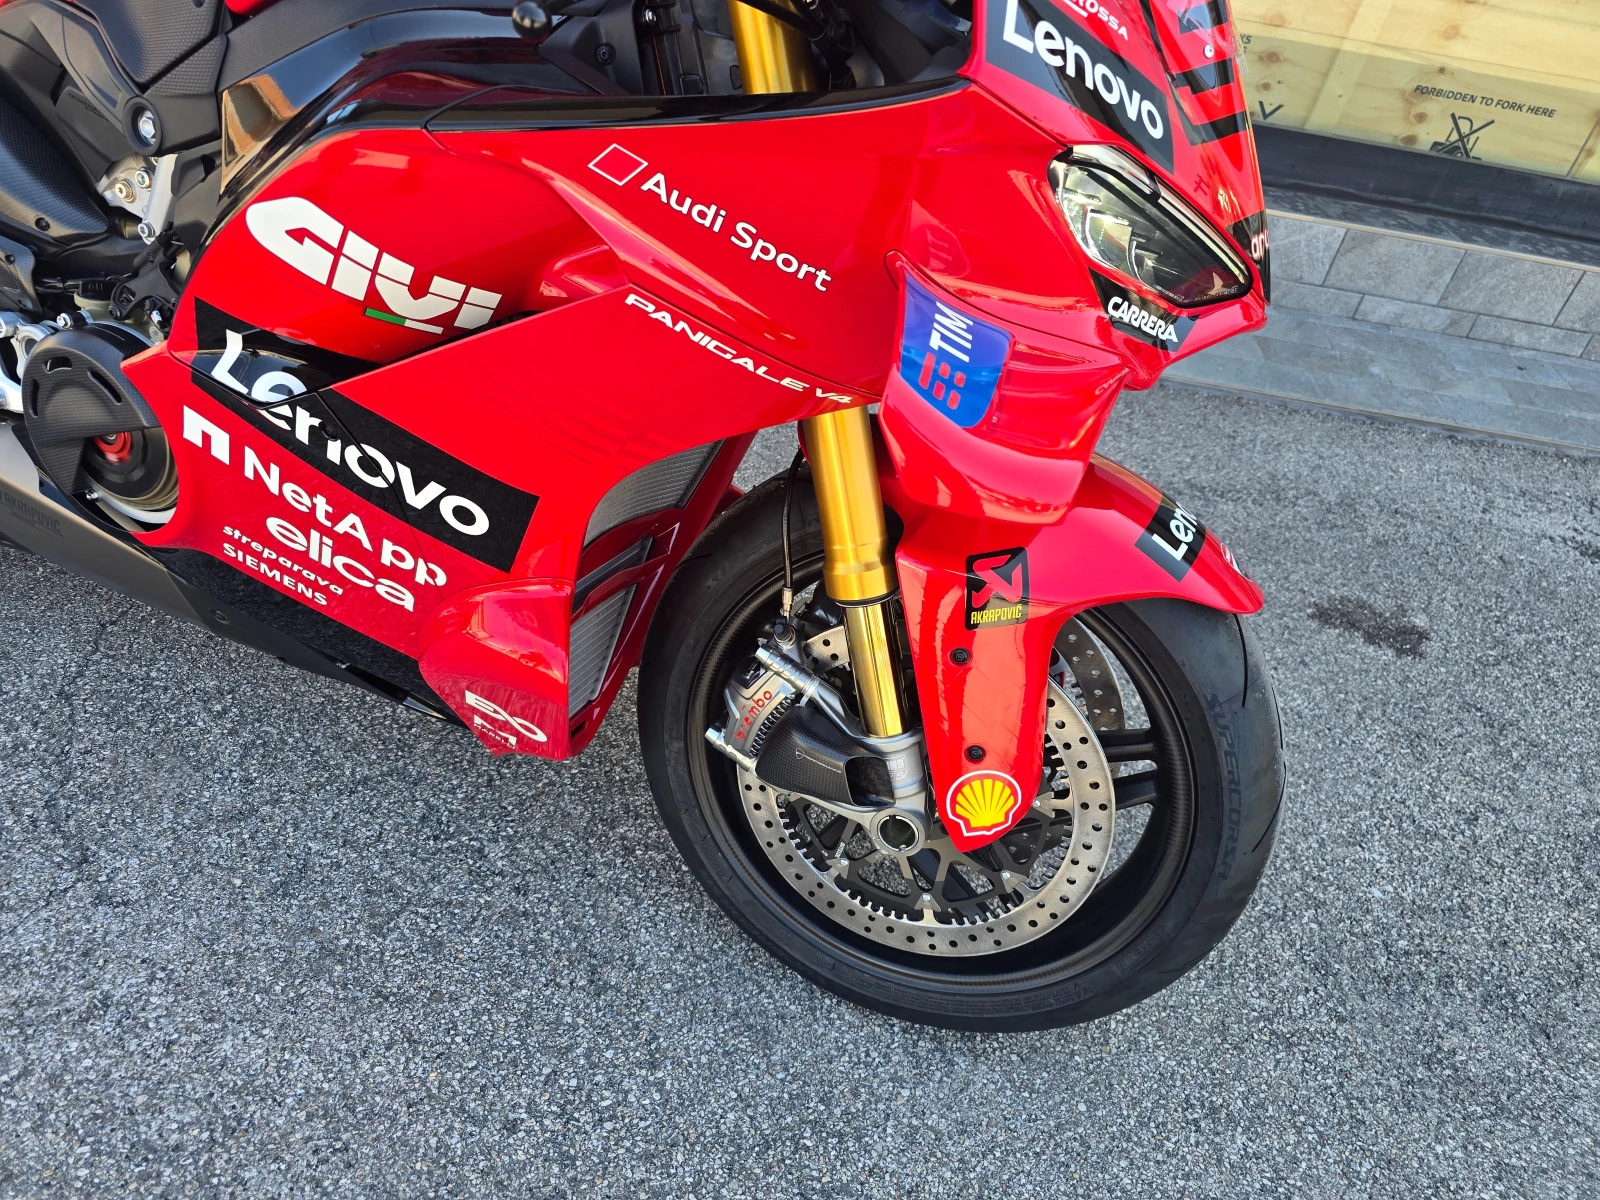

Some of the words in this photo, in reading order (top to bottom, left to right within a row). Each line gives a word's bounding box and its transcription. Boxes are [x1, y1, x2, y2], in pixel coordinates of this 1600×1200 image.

[1003, 0, 1164, 140] Lenovo
[1413, 84, 1478, 104] FORBIDDEN
[1479, 96, 1494, 107] TO
[1494, 99, 1526, 113] FORK
[1525, 105, 1557, 118] HERE
[246, 196, 503, 331] GIVI
[641, 173, 727, 234] Audi
[730, 221, 833, 293] Sport
[624, 293, 811, 393] PANIGALE
[814, 387, 854, 404] V4
[929, 301, 974, 363] TIM
[1107, 295, 1179, 343] CARRERA
[211, 329, 490, 536] Lenovo
[222, 525, 344, 596] streparava
[223, 541, 328, 607] SIEMENS
[265, 516, 415, 613] elica
[733, 690, 773, 742] brembo
